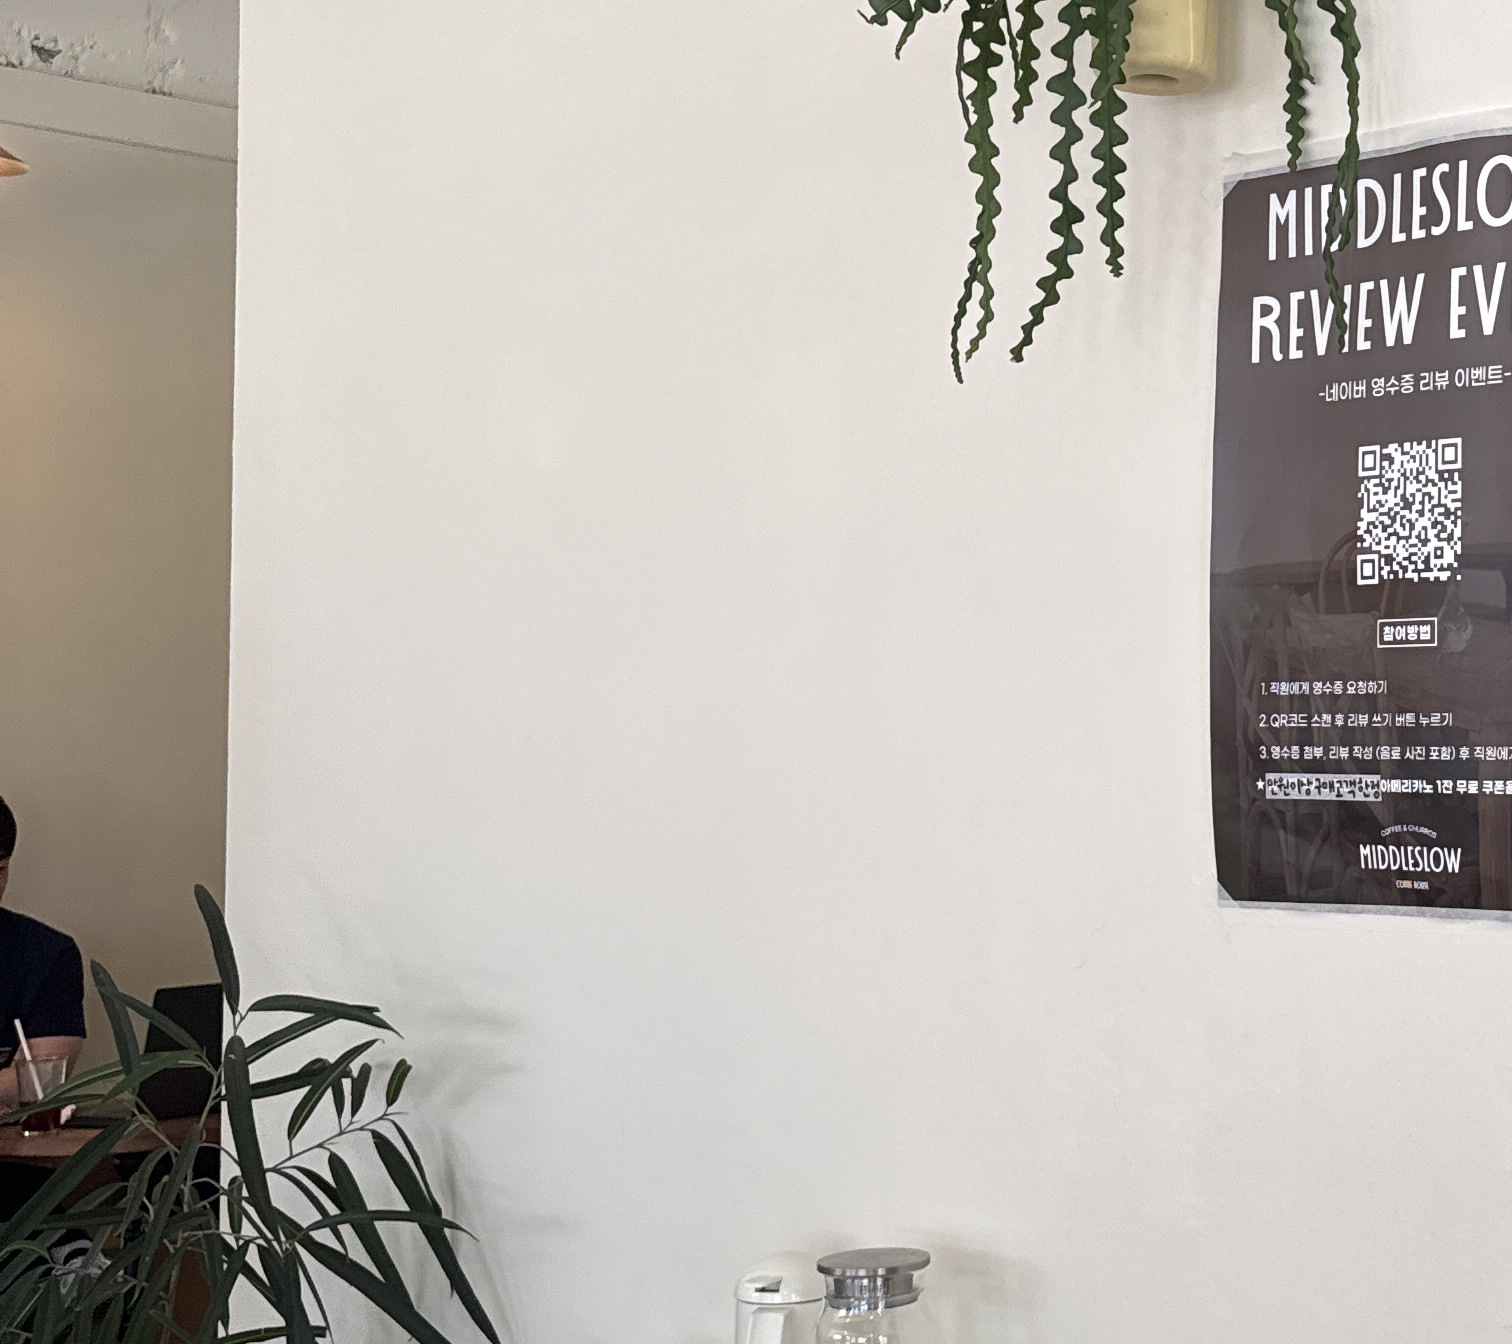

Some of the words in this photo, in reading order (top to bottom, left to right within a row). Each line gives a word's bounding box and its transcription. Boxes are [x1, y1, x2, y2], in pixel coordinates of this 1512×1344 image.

[1251, 272, 1425, 364] REVIEW
[1371, 372, 1416, 398] 영수증
[1419, 369, 1450, 392] 리뷰
[1382, 624, 1432, 642] 참여방법
[1269, 681, 1310, 696] 직원에게
[1312, 680, 1344, 695] 영수증
[1346, 679, 1388, 695] 요청하기
[1310, 713, 1332, 727] 스캔
[1334, 712, 1345, 727] 후
[1347, 712, 1369, 727] 리뷰
[1371, 712, 1392, 727] 쓰기
[1395, 712, 1416, 727] 버튼
[1419, 712, 1453, 727] 누르기
[1270, 745, 1300, 760] 영수증
[1328, 745, 1350, 760] 리뷰
[1352, 745, 1373, 760] 작성
[1404, 745, 1425, 760] 사진
[1458, 745, 1470, 760] 후
[1436, 779, 1454, 794] 1잔
[1456, 779, 1479, 794] 무료
[1359, 843, 1462, 873] MIDDLESLOW
